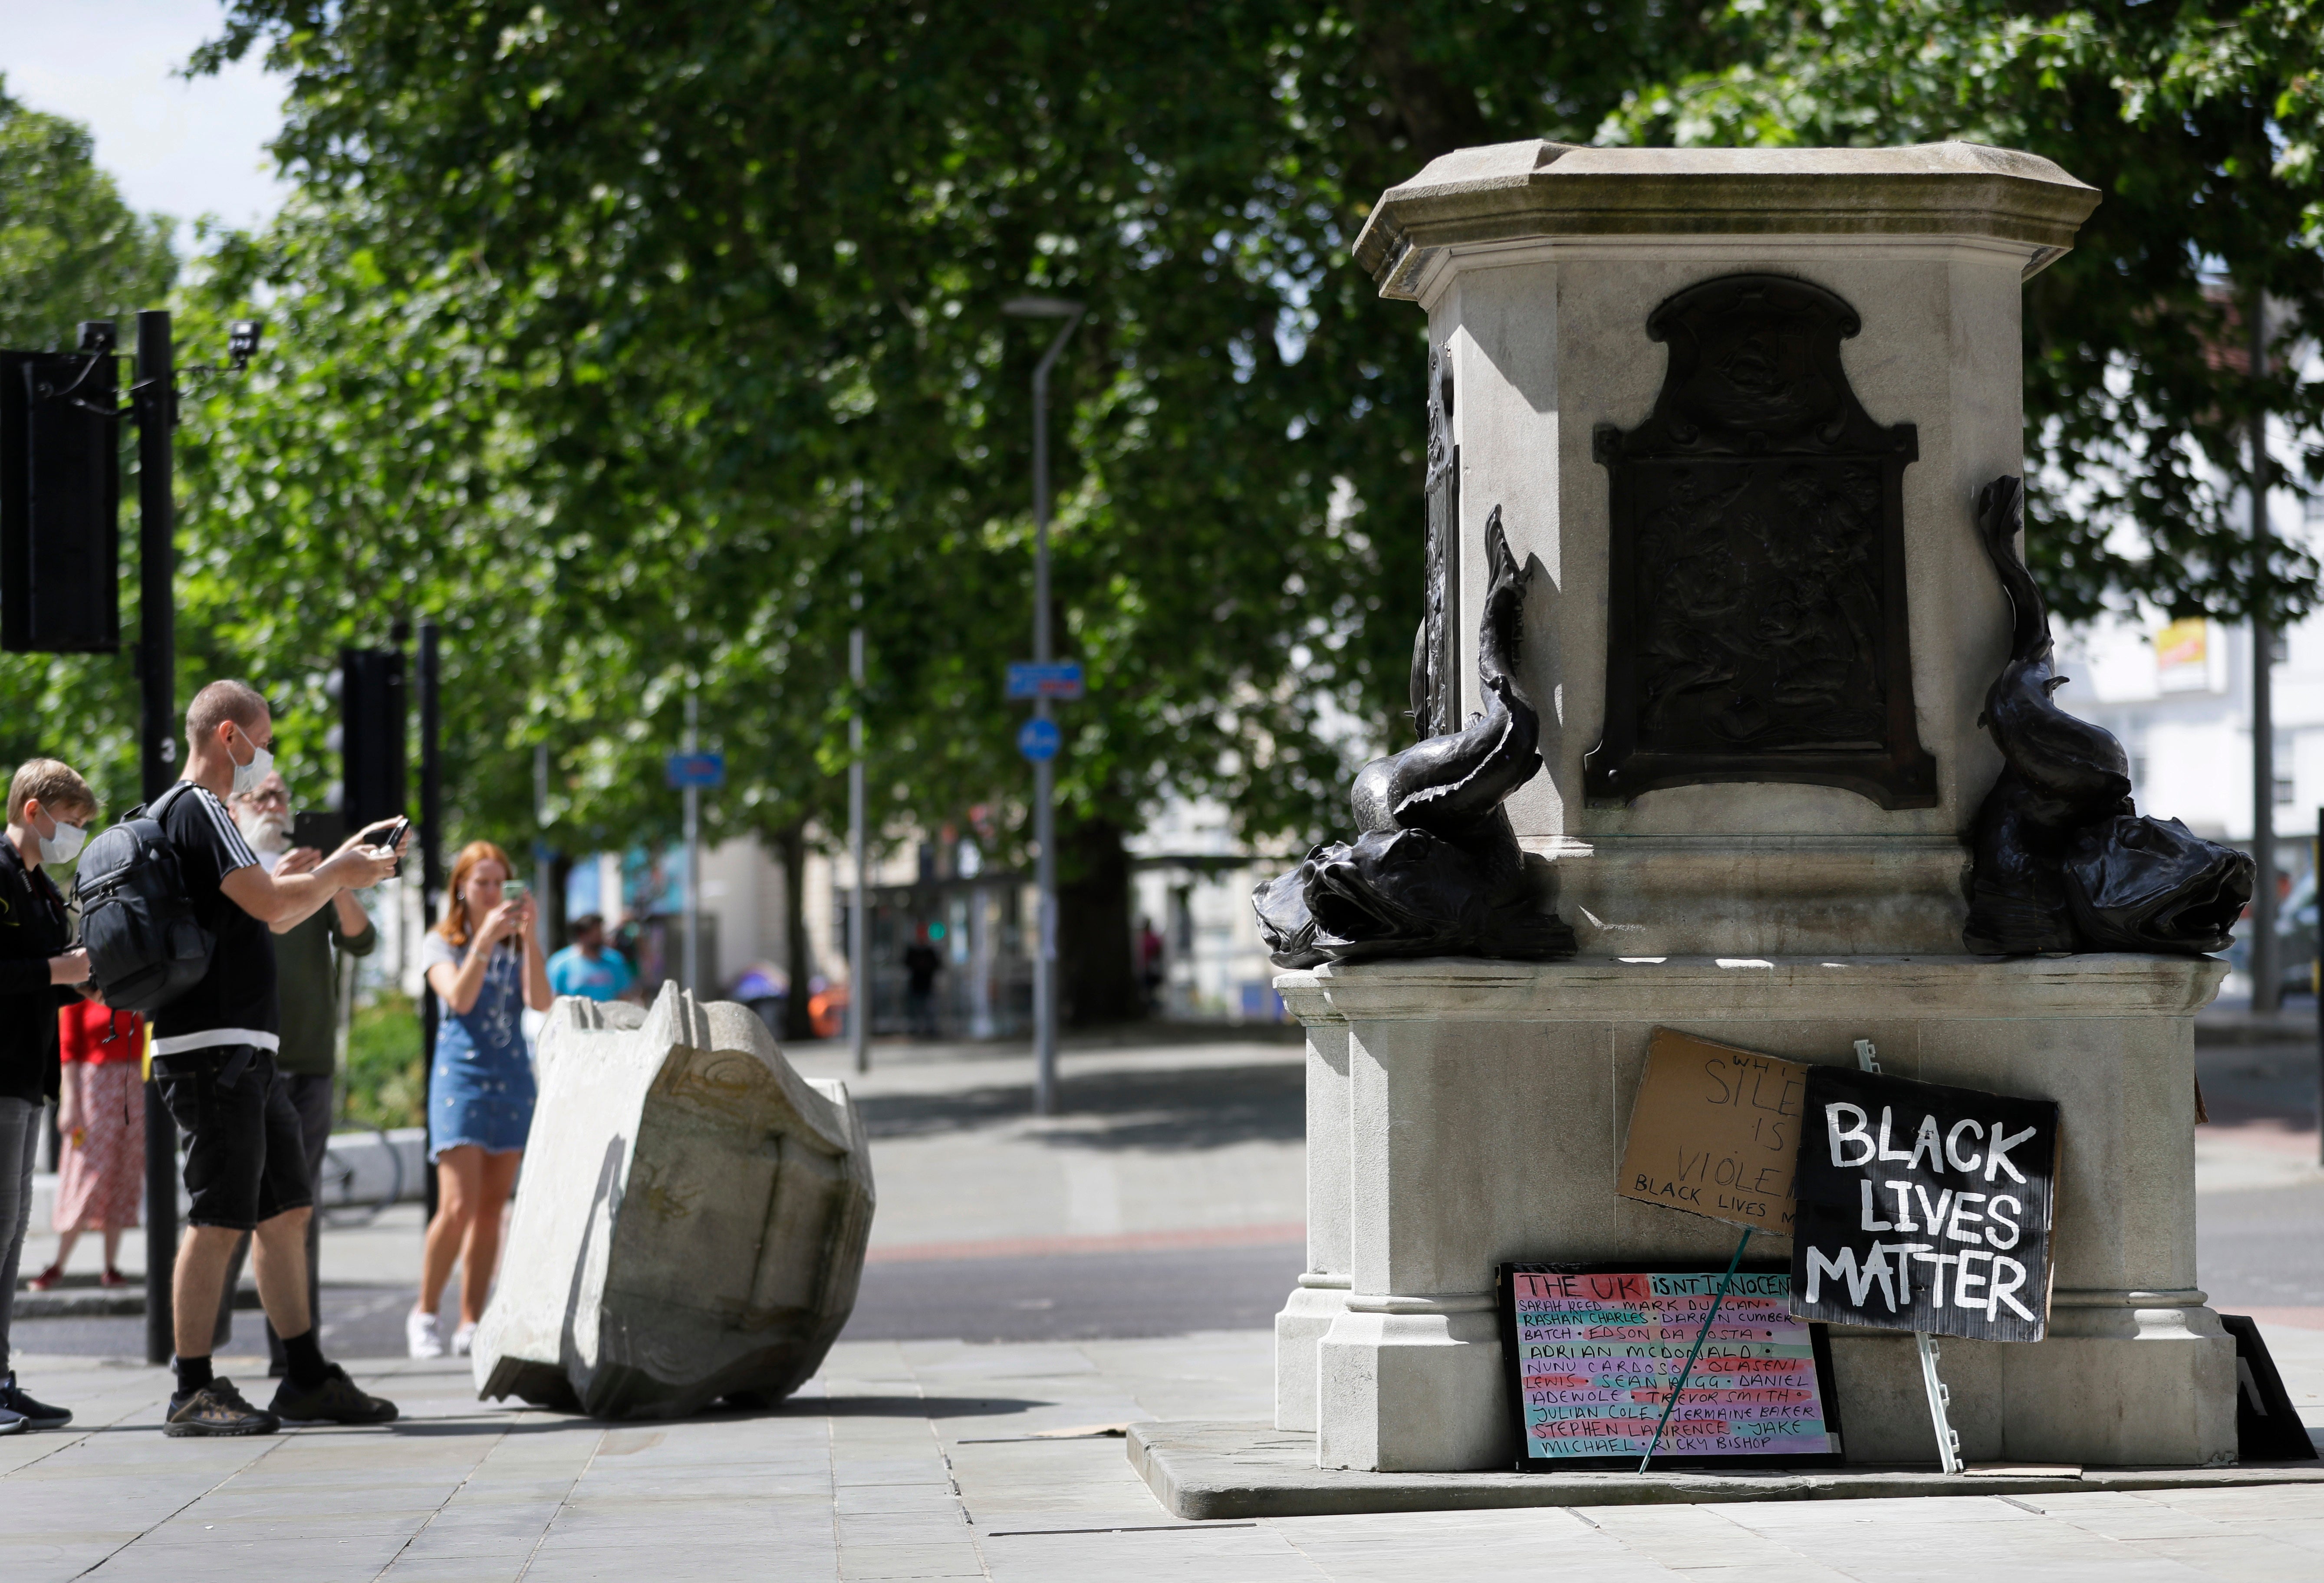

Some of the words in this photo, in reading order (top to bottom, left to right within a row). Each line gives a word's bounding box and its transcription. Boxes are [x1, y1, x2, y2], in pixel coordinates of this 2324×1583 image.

[161, 737, 176, 763] 3
[1733, 1055, 1807, 1076] WHI
[1755, 1118, 1784, 1151] IS
[1825, 1102, 2036, 1184] BLACK
[1634, 1174, 1701, 1206] BLACK
[1718, 1194, 1766, 1217] LIVES
[1860, 1179, 2021, 1250] LIVES
[1519, 1275, 1584, 1298] THE
[1591, 1276, 1642, 1299] UK
[1805, 1239, 2036, 1322] MATTER
[1519, 1300, 1562, 1312] SARAH
[1568, 1301, 1602, 1314] REED
[1624, 1300, 1677, 1312] MARK
[1689, 1300, 1761, 1311] DUGAN
[1524, 1314, 1583, 1327] RASHAN
[1590, 1312, 1649, 1324] CHARLES
[1662, 1313, 1730, 1324] DARRN
[1738, 1313, 1796, 1325] CUMBER
[1524, 1328, 1571, 1341] BATCH
[1589, 1324, 1650, 1340] EDSON
[1660, 1328, 1684, 1340] DA
[1531, 1345, 1611, 1360] ADRIAN
[1626, 1345, 1751, 1360] MCDONALD
[1527, 1361, 1576, 1374] NUNU
[1588, 1361, 1682, 1375] CARDOSO
[1708, 1359, 1797, 1373] OLASENI
[1526, 1373, 1575, 1389] LEWIS
[1602, 1374, 1658, 1389] SEAN
[1669, 1376, 1718, 1391] RIGG
[1739, 1374, 1808, 1387] DANIEL
[1532, 1389, 1619, 1405] ADEWOLE
[1646, 1391, 1718, 1405] TREVOR
[1726, 1389, 1789, 1402] SMITH
[1533, 1406, 1598, 1422] JULIAN
[1608, 1405, 1654, 1420] COLE
[1670, 1407, 1752, 1422] JERMAINE
[1760, 1406, 1816, 1418] BAKER
[1535, 1421, 1618, 1439] STEPHEN
[1628, 1421, 1731, 1439] LAWRENCE
[1748, 1420, 1801, 1435] JAKE
[1541, 1438, 1637, 1454] MICHAEL
[1654, 1438, 1708, 1451] RICKY
[1716, 1437, 1771, 1450] BISHOP
